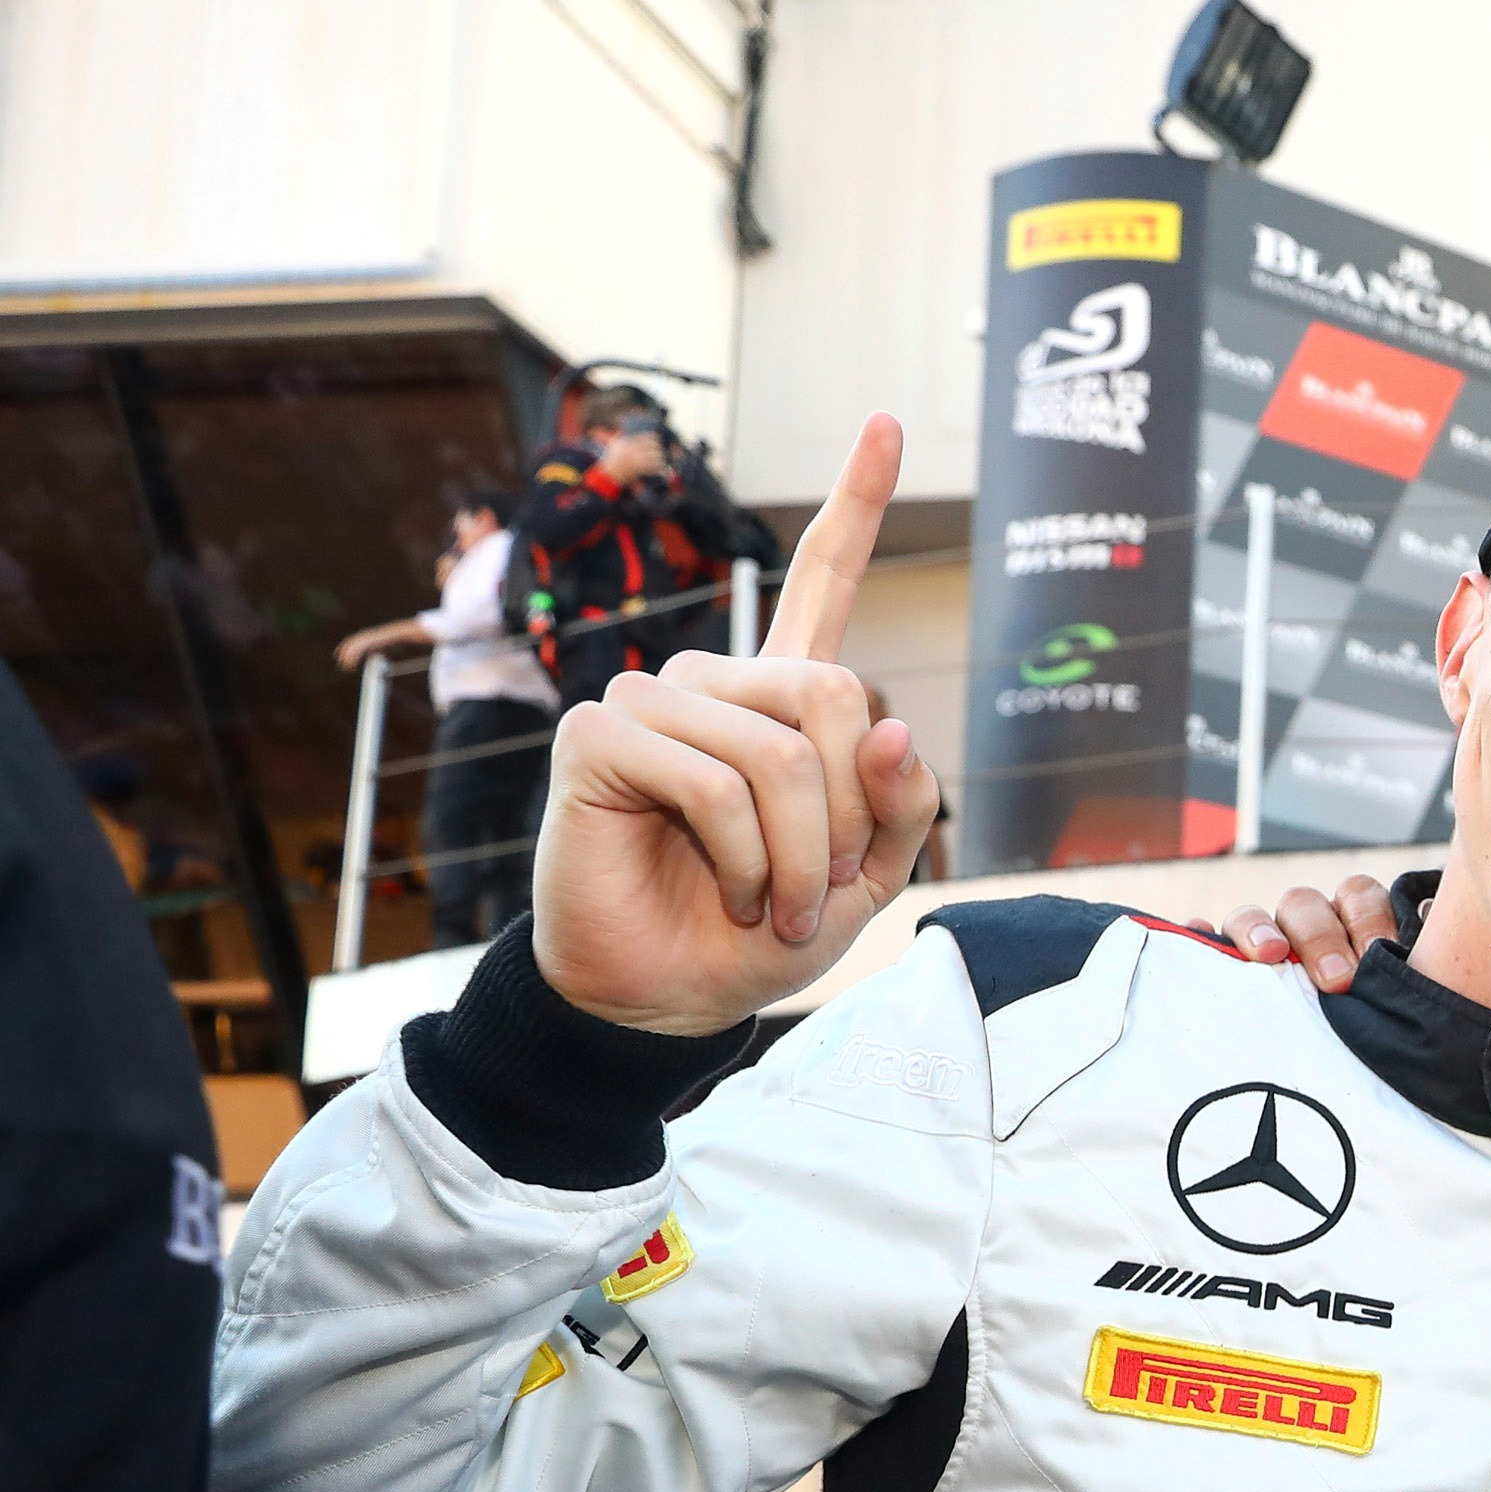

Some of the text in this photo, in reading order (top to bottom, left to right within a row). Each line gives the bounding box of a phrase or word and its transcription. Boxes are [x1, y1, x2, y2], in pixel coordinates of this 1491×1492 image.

[995, 683, 1142, 717] COYOTE
[1190, 1275, 1396, 1329] AMG
[1111, 1347, 1357, 1435] PIRELLI
